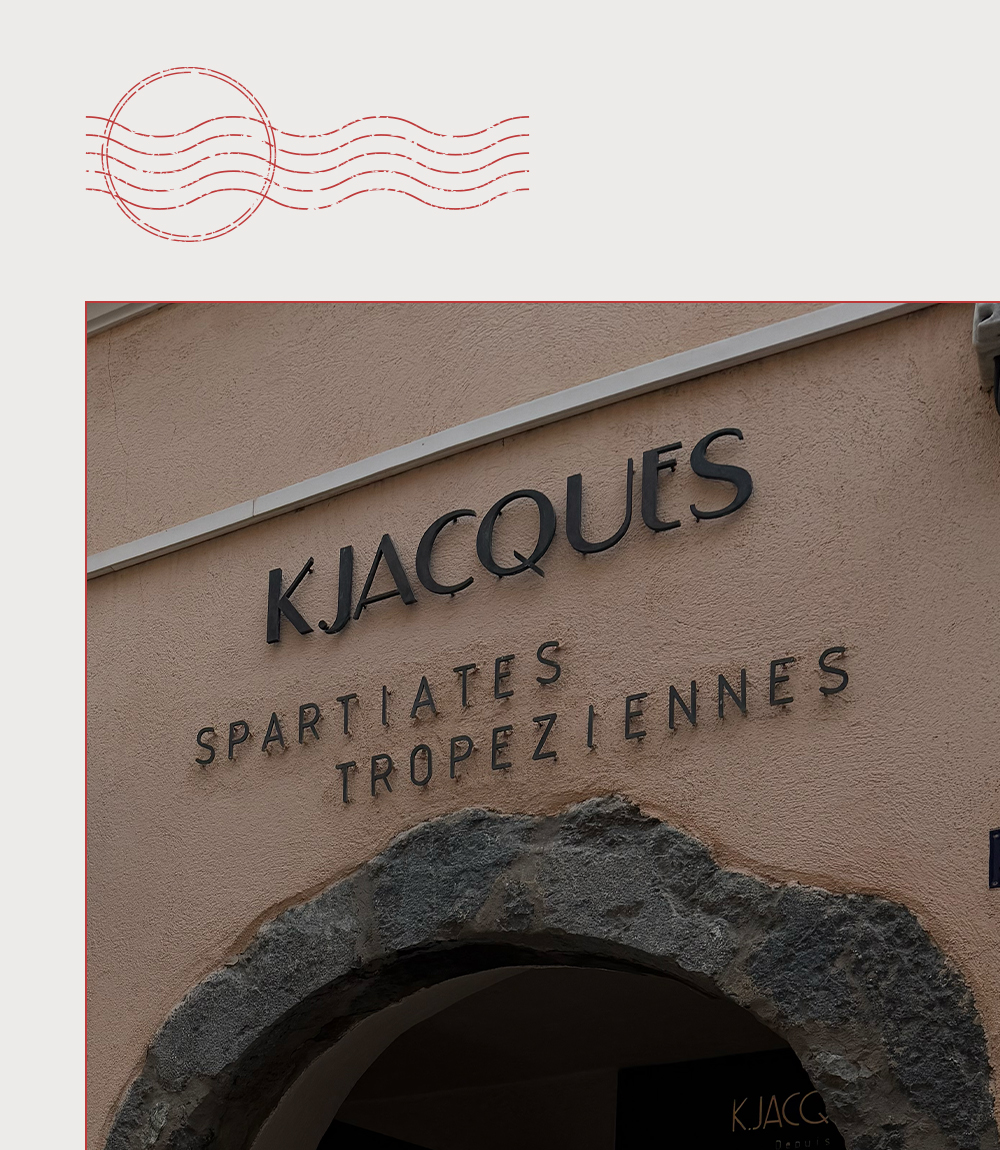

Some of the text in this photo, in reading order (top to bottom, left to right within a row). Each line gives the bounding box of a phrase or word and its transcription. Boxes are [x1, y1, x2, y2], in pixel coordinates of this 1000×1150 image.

[195, 640, 562, 766] SPARTIATES
[335, 645, 849, 804] TROPEZIENNES
[775, 1137, 831, 1150] Depuis
